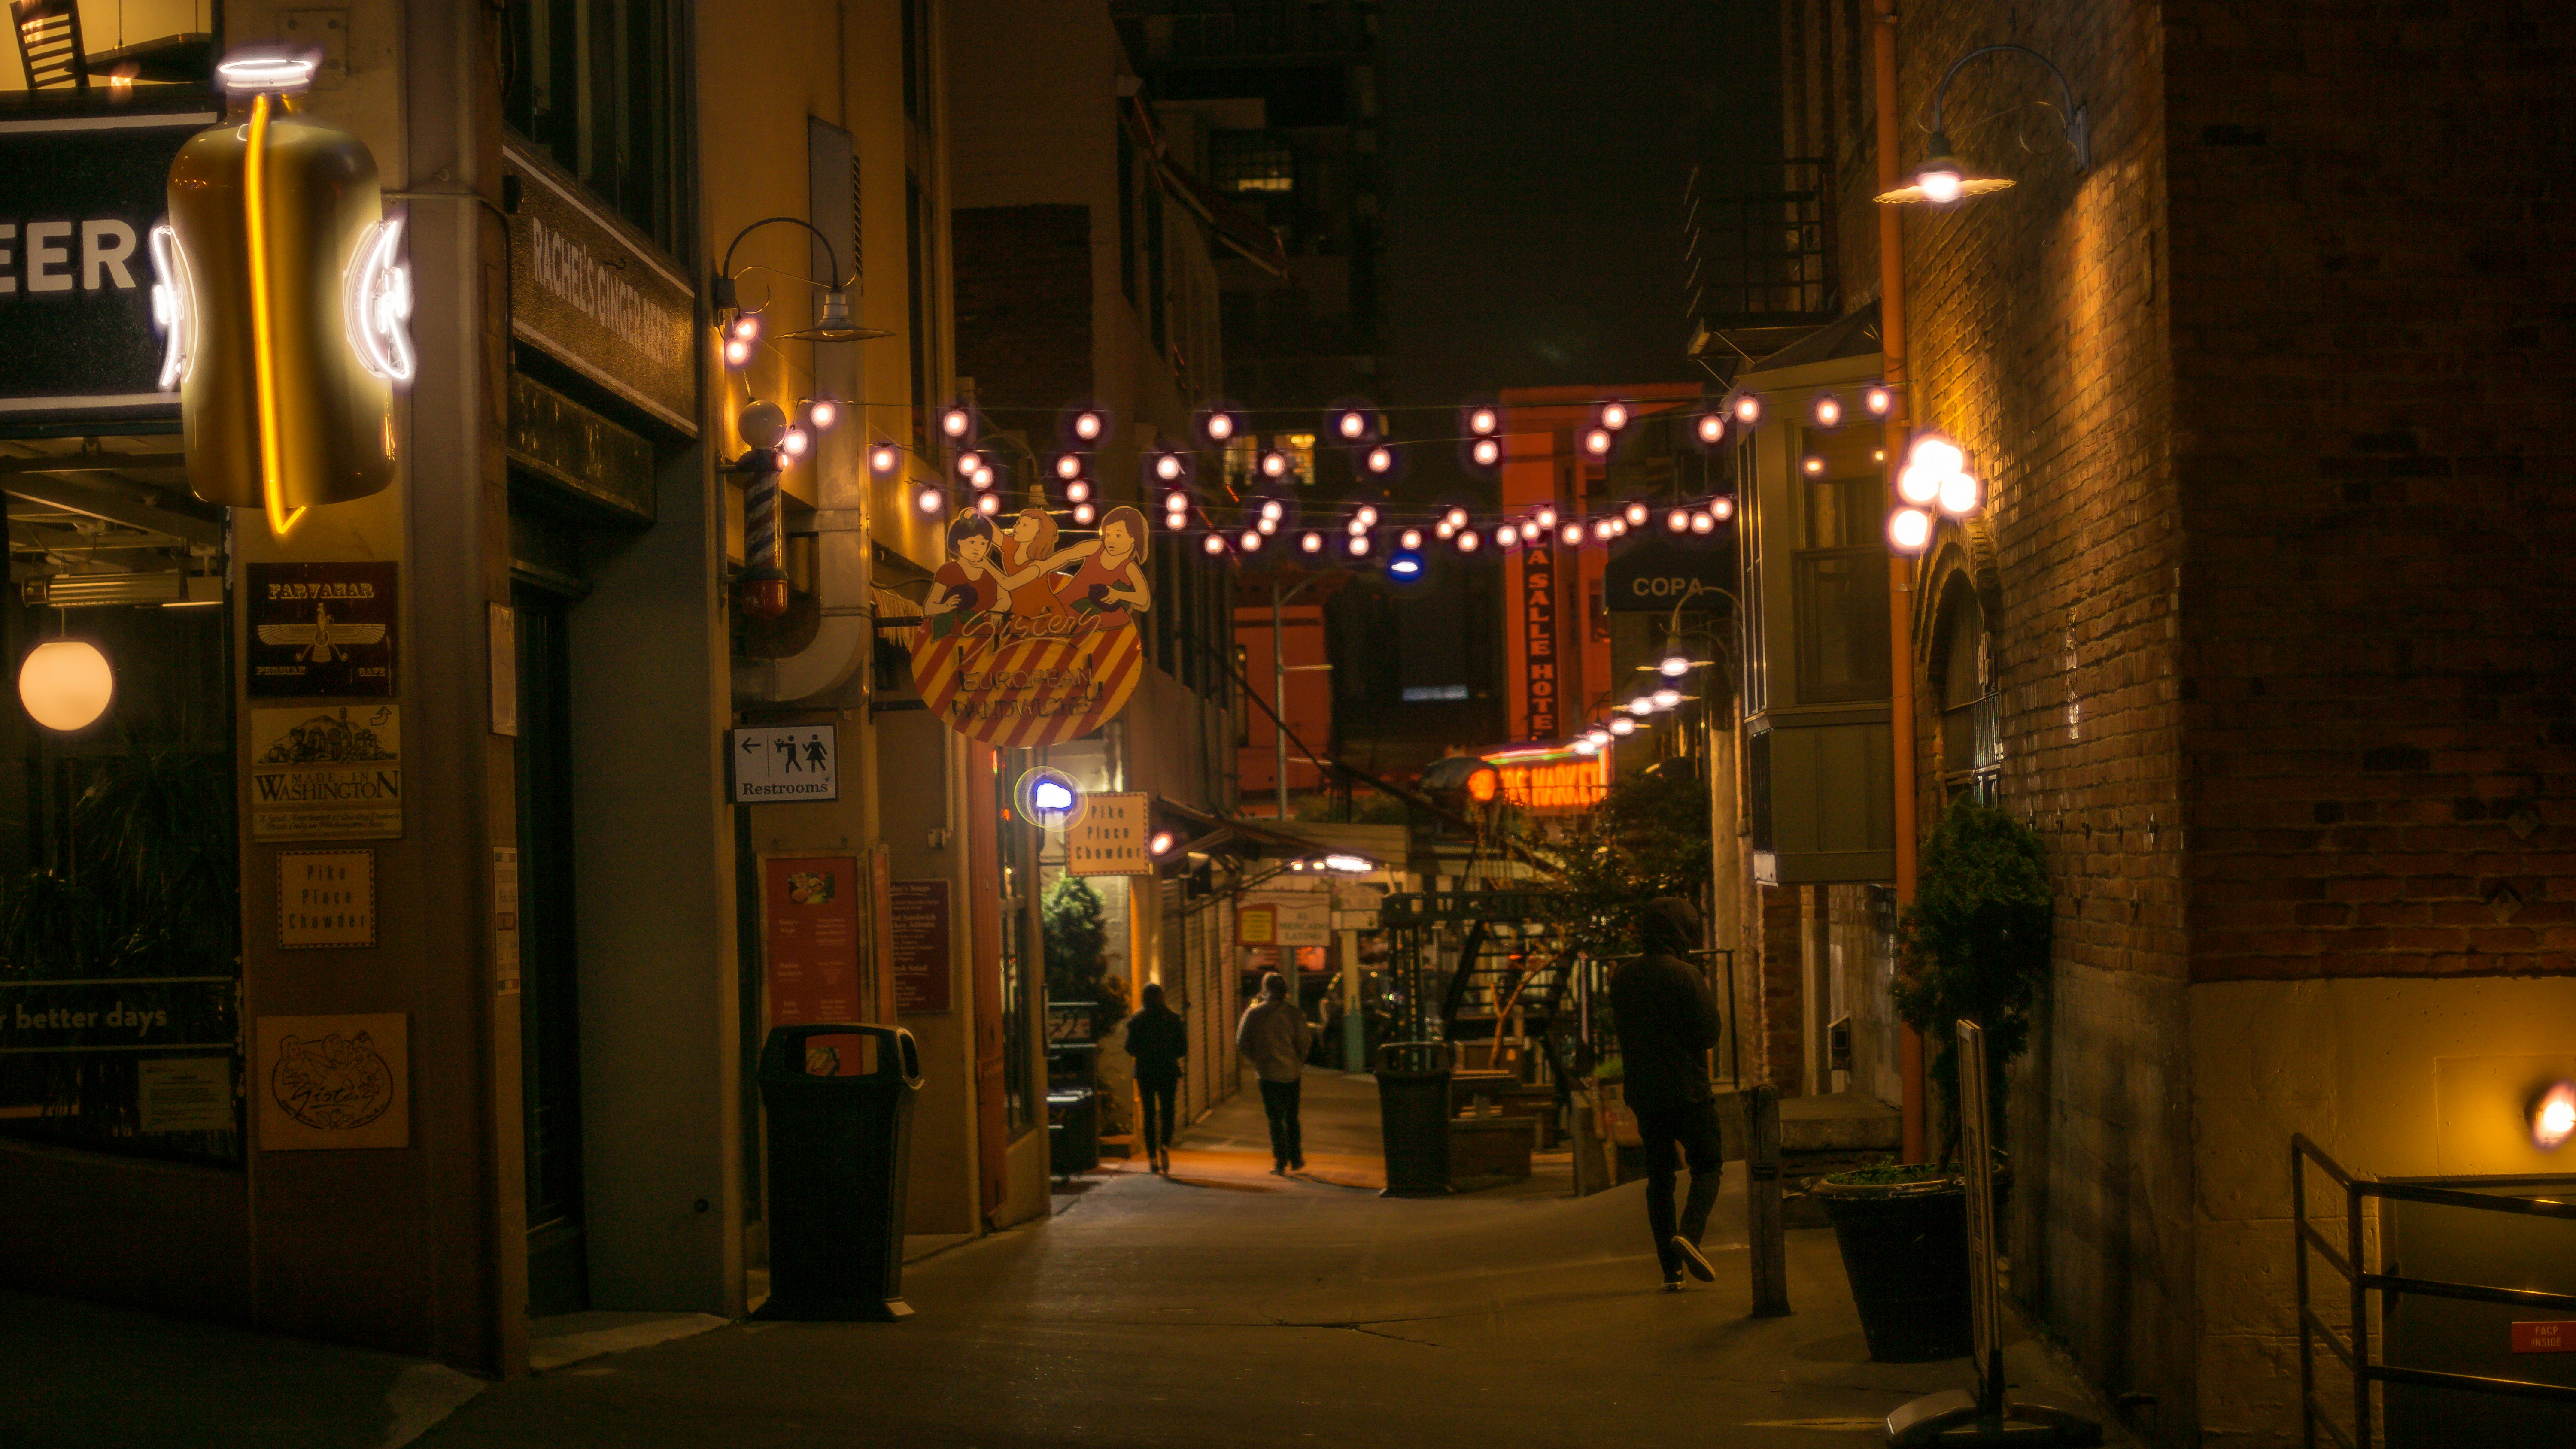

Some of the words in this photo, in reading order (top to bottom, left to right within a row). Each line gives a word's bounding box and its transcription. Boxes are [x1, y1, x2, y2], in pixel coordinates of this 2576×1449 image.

[534, 217, 594, 320] RACHEL'S
[598, 266, 641, 353] GINGER
[269, 583, 374, 599] FARVAHAR
[1633, 577, 1704, 596] COPA
[1528, 573, 1550, 655] SALLE
[960, 607, 1102, 666] Sisters
[255, 666, 305, 675] PERSIAN
[963, 668, 1094, 692] EUROPEAN
[1531, 664, 1554, 735] HOTE
[292, 772, 335, 783] MADE
[352, 772, 368, 782] IN
[254, 770, 399, 802] WASHINGTON
[742, 783, 828, 795] Restrooms
[1091, 805, 1124, 819] Pike
[1088, 826, 1129, 839] Place
[1076, 845, 1140, 860] Chowder
[307, 865, 345, 880] Pike
[302, 889, 351, 904] Place
[289, 912, 365, 929] Chowder
[16, 1003, 99, 1029] better
[106, 1000, 169, 1037] days
[2535, 1326, 2558, 1335] FACP
[2532, 1337, 2561, 1346] INSIDE
